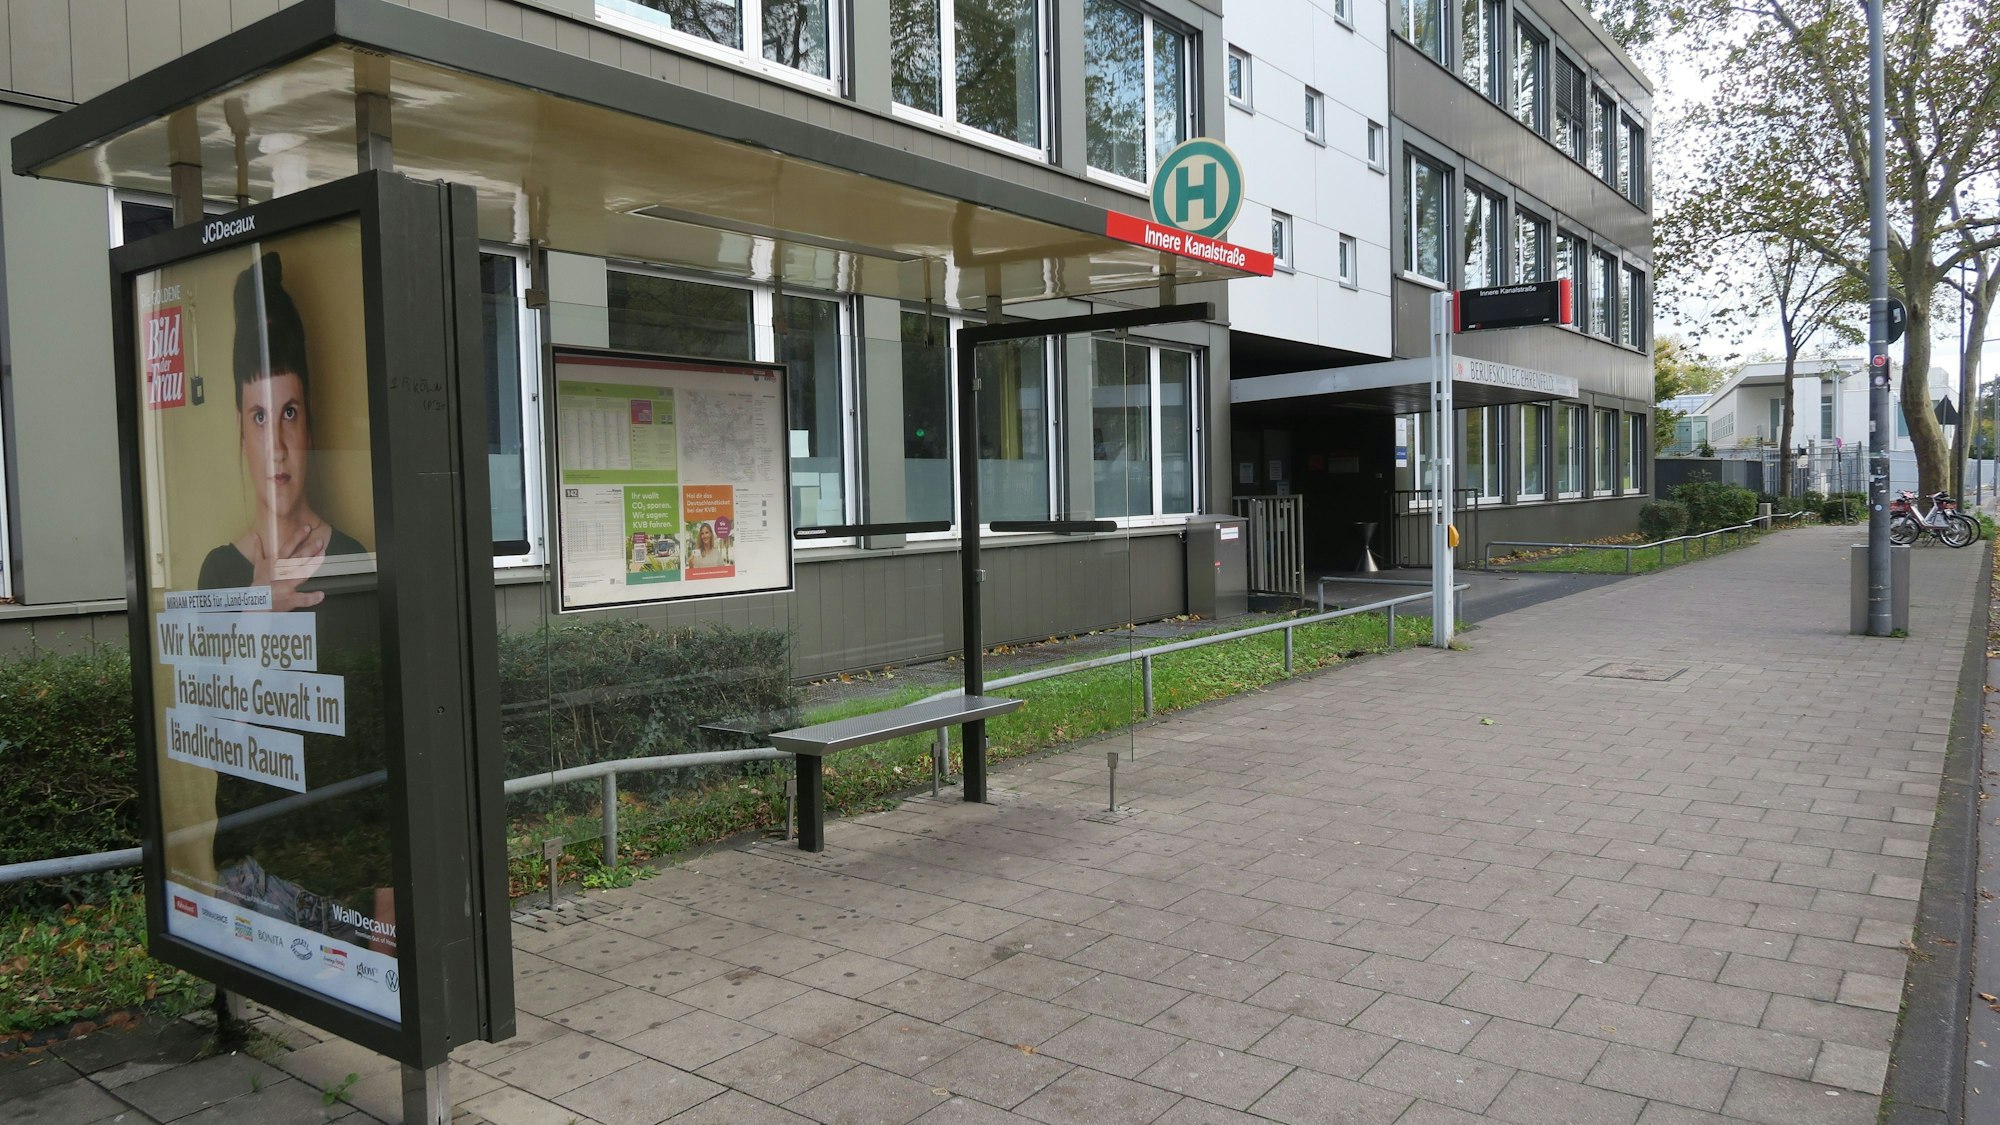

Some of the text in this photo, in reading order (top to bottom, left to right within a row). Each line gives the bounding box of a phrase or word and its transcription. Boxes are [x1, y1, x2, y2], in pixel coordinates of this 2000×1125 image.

[1176, 162, 1217, 223] H
[202, 214, 255, 245] JCDecaux
[1145, 224, 1246, 267] Innere Kanalstraße
[1500, 285, 1537, 295] Kanalstraße
[148, 313, 180, 360] Bild
[160, 358, 172, 372] der
[149, 362, 183, 404] Frau
[631, 491, 641, 500] Ihr
[642, 491, 660, 500] wollt
[646, 502, 672, 511] sparen.
[632, 511, 645, 519] Wir
[632, 520, 673, 528] KVB fahren.
[167, 595, 188, 609] MIRIAM
[189, 594, 212, 609] PETERS
[213, 594, 222, 607] für
[160, 622, 313, 669] Wir kämpfen gegen
[178, 670, 340, 725] häusliche Gewalt im
[171, 717, 299, 782] ländlichen Raum.
[332, 903, 396, 938] WallDecaux
[257, 929, 285, 948] BONITA
